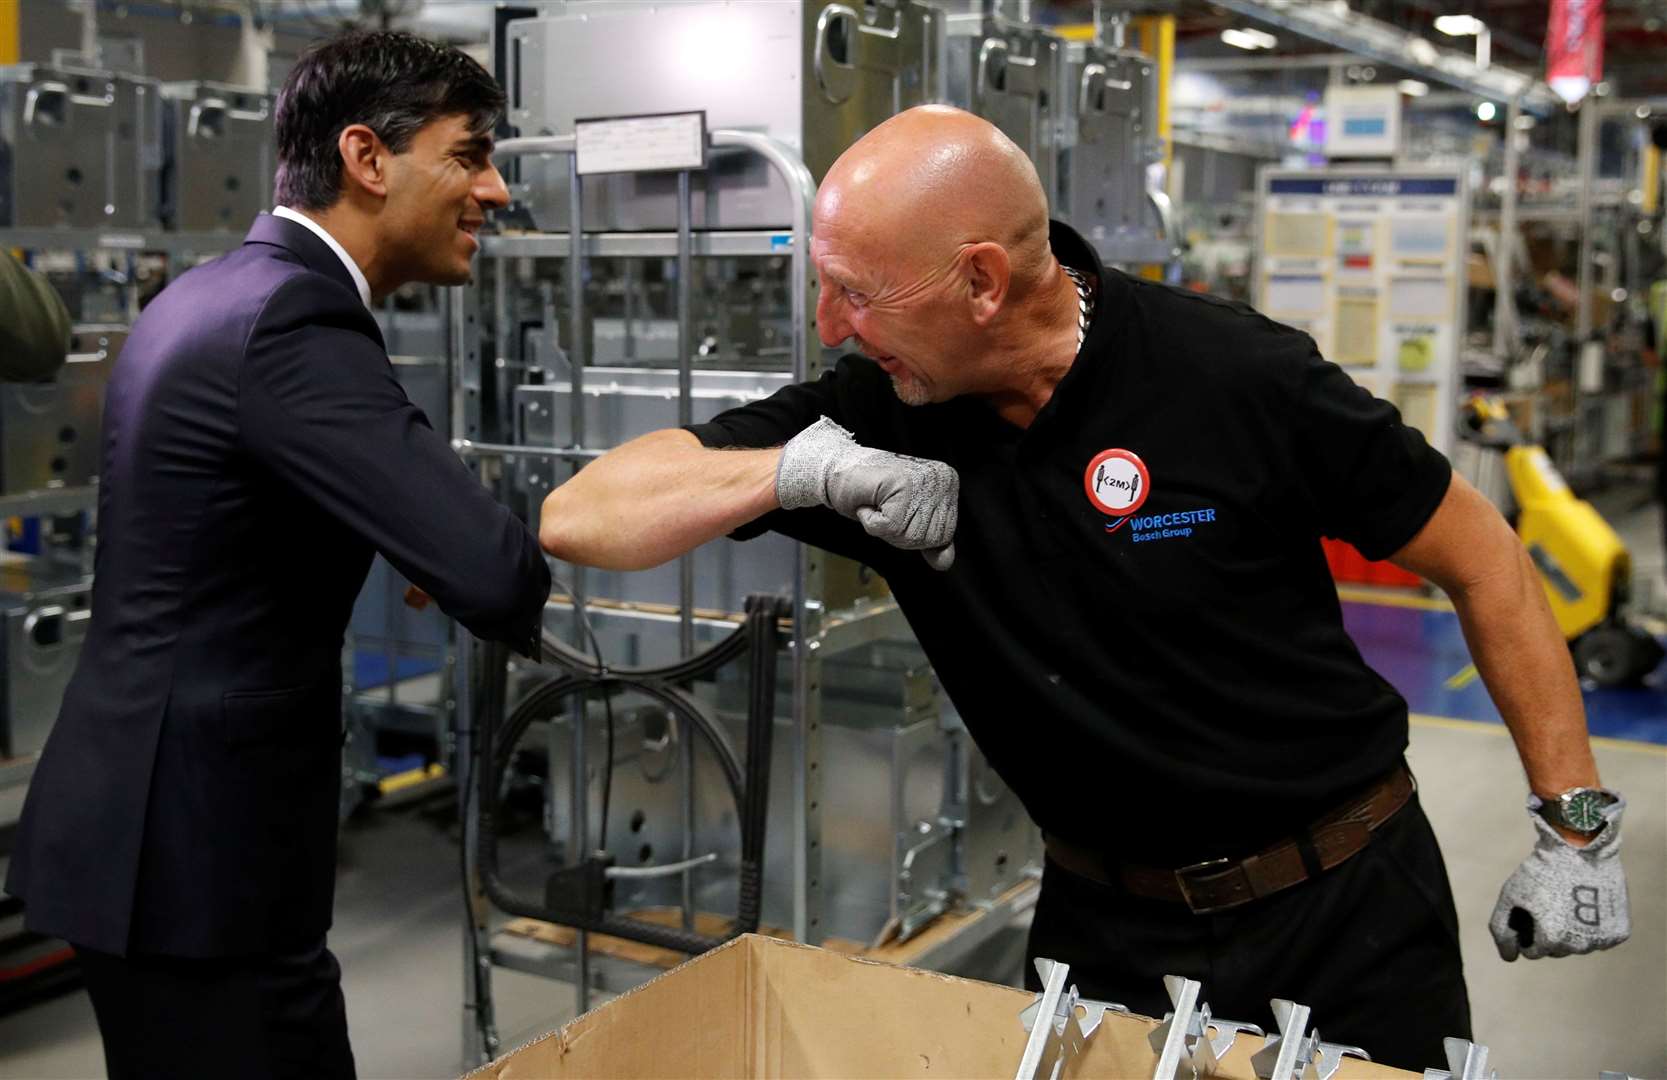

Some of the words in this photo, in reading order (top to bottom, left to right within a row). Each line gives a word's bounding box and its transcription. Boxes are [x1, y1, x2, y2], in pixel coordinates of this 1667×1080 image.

[1130, 509, 1216, 530] WORCESTER
[1132, 530, 1162, 542] Bosch
[1162, 527, 1192, 537] Group
[1573, 885, 1599, 926] B
